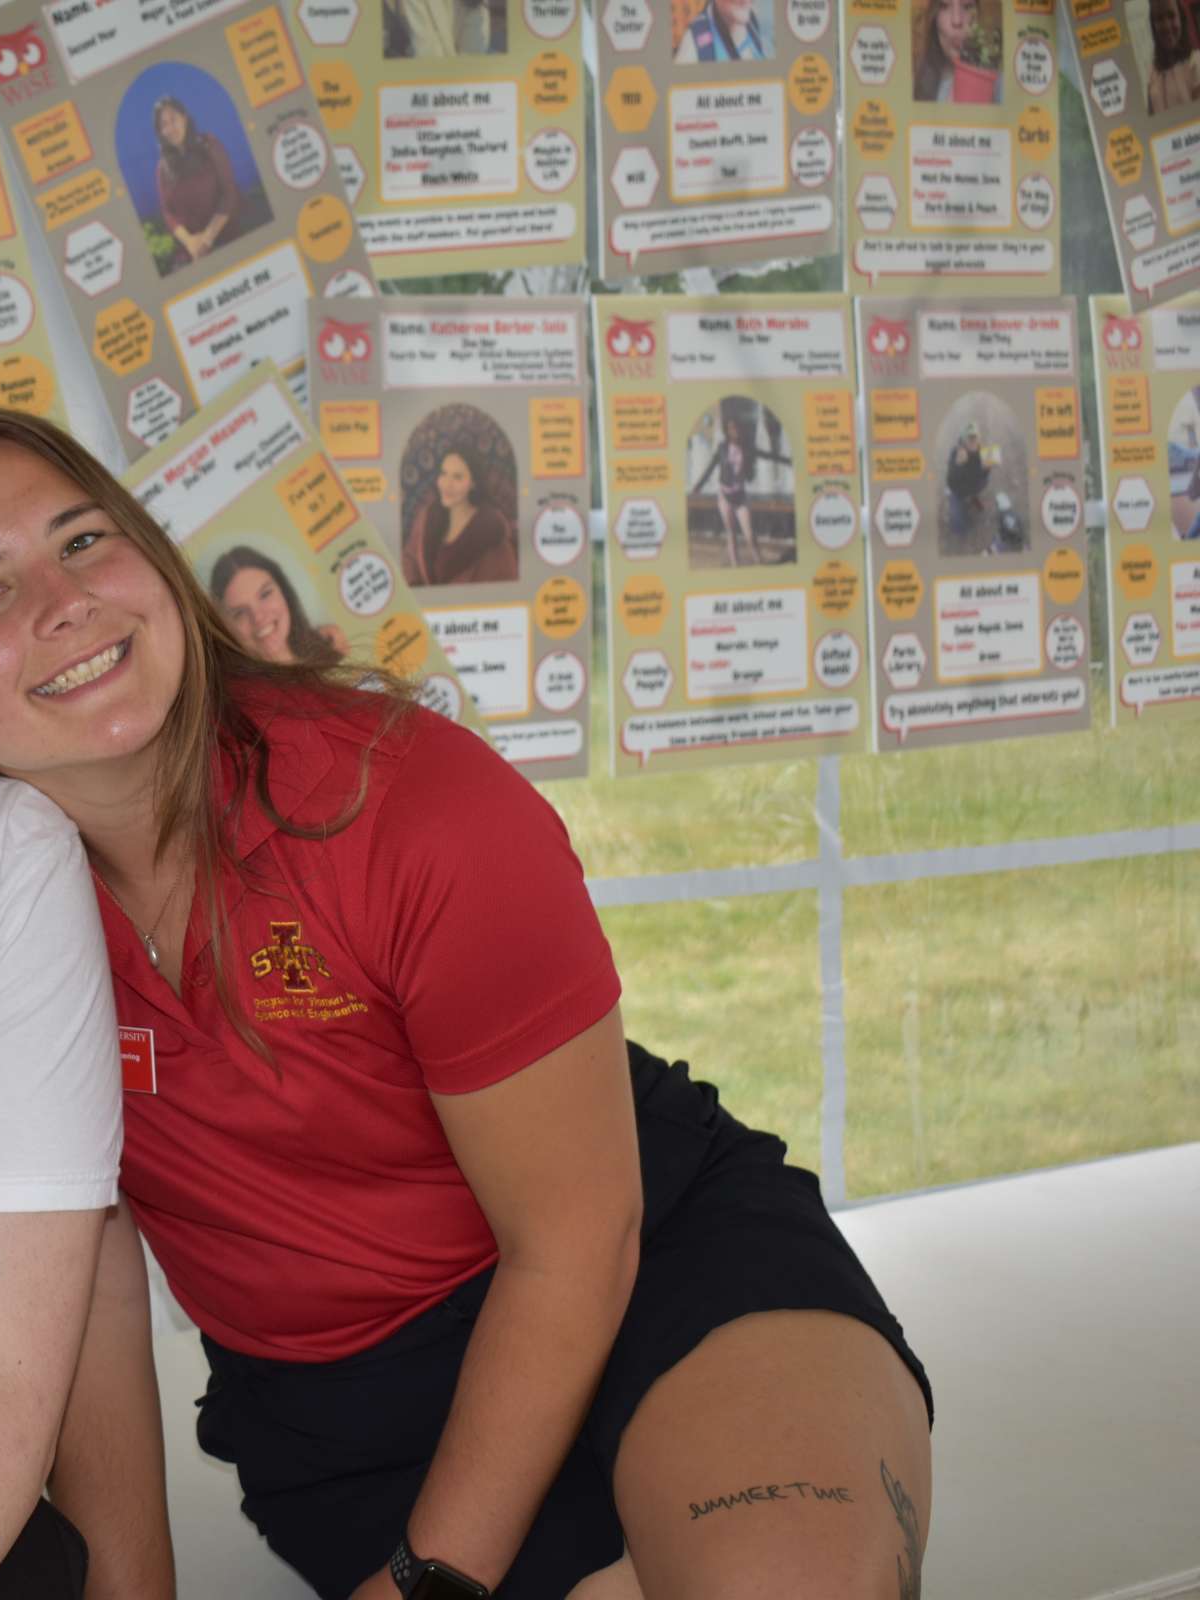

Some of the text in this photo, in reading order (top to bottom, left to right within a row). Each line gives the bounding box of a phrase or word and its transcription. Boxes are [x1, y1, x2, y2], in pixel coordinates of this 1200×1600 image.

[432, 91, 469, 108] about
[473, 92, 492, 104] me
[715, 93, 744, 108] about
[949, 135, 975, 149] about
[217, 278, 252, 306] about
[253, 269, 270, 285] me
[732, 599, 764, 613] about
